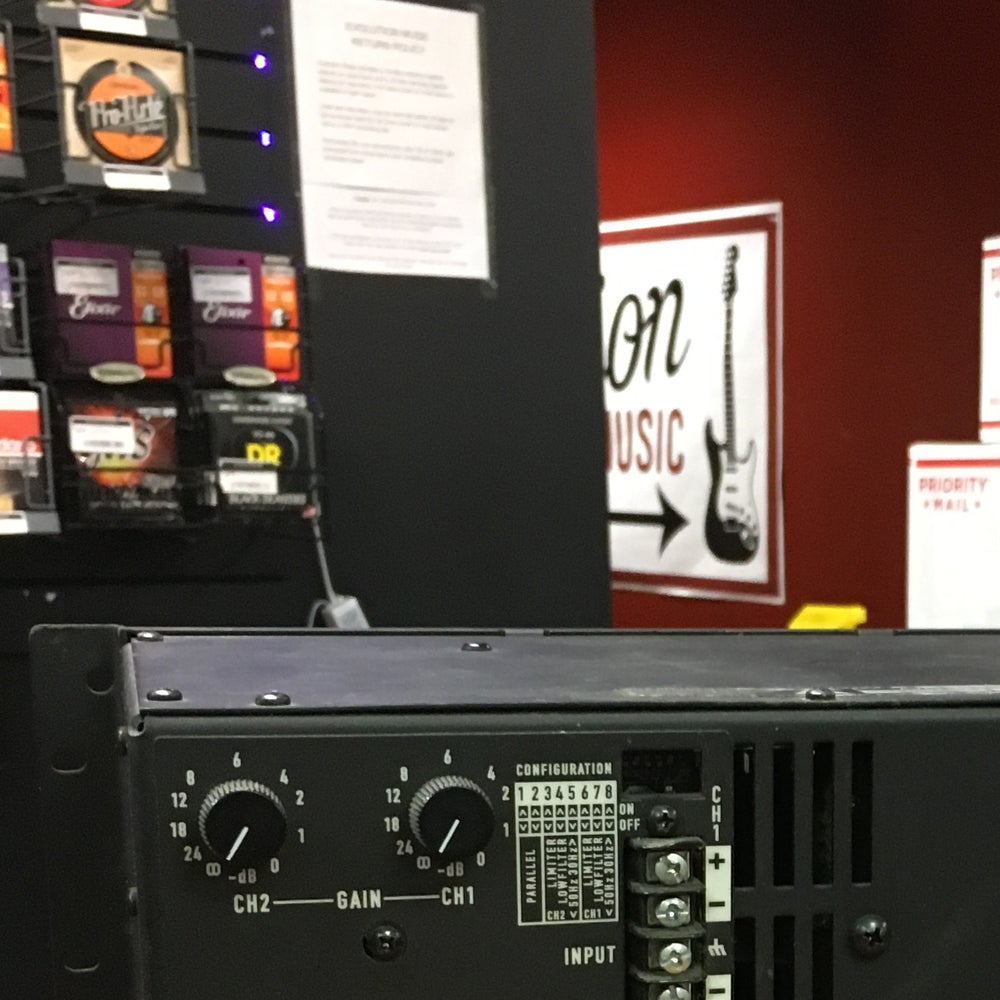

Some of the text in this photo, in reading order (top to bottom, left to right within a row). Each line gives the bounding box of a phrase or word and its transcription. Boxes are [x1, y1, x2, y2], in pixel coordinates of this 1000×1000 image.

[600, 278, 691, 391] on
[246, 443, 281, 466] DR
[919, 477, 988, 494] PRIORITY
[933, 498, 969, 512] MAIL
[233, 752, 241, 768] 6
[443, 749, 452, 764] 6
[400, 767, 408, 781] 8
[487, 766, 496, 781] 4
[516, 762, 613, 776] CONFIGURATION
[186, 771, 195, 786] 8
[279, 769, 289, 785] 4
[171, 792, 188, 808] 12
[296, 790, 304, 805] 2
[386, 788, 401, 803] 12
[502, 786, 510, 801] 2
[518, 784, 612, 801] 1 2 3 4 5 6 7 8
[619, 803, 634, 815] ON
[170, 822, 187, 838] 18
[384, 817, 400, 832] 18
[503, 823, 509, 837] 1
[619, 818, 641, 831] OFF
[298, 828, 304, 844] 1
[184, 846, 202, 861] 24
[396, 841, 413, 855] 24
[546, 838, 557, 888] LIMITER
[583, 837, 593, 886] LIMITER
[525, 849, 537, 904] PARALLEL
[568, 848, 579, 907] 50Hz 30Hz
[603, 846, 615, 905] 50Hz 30Hz
[234, 886, 475, 913] CH2 GAIN CH1
[547, 911, 566, 920] CH2
[584, 909, 602, 919] CH1
[564, 945, 617, 966] INPUT
